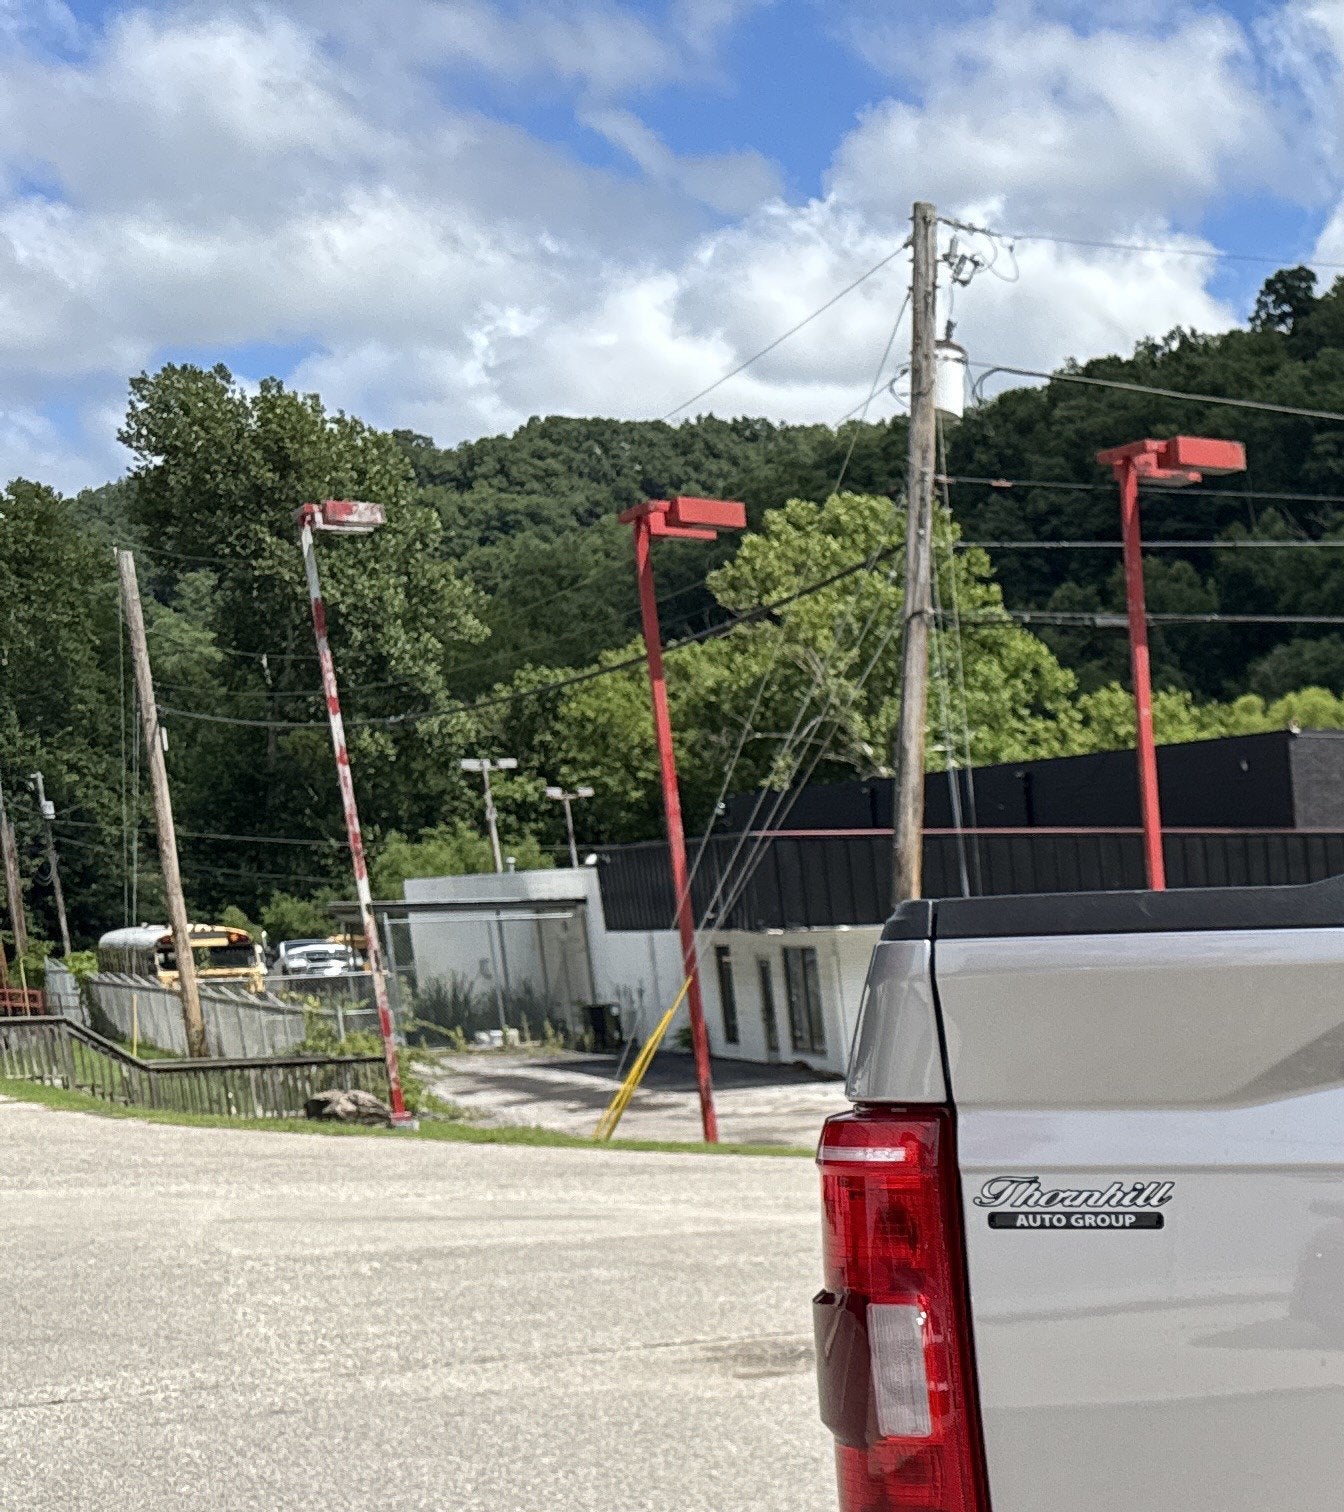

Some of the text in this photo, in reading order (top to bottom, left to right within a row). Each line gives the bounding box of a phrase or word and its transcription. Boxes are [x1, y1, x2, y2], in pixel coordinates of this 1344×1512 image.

[973, 1175, 1175, 1208] Thornhill
[1016, 1214, 1137, 1228] AUTO GROUP
